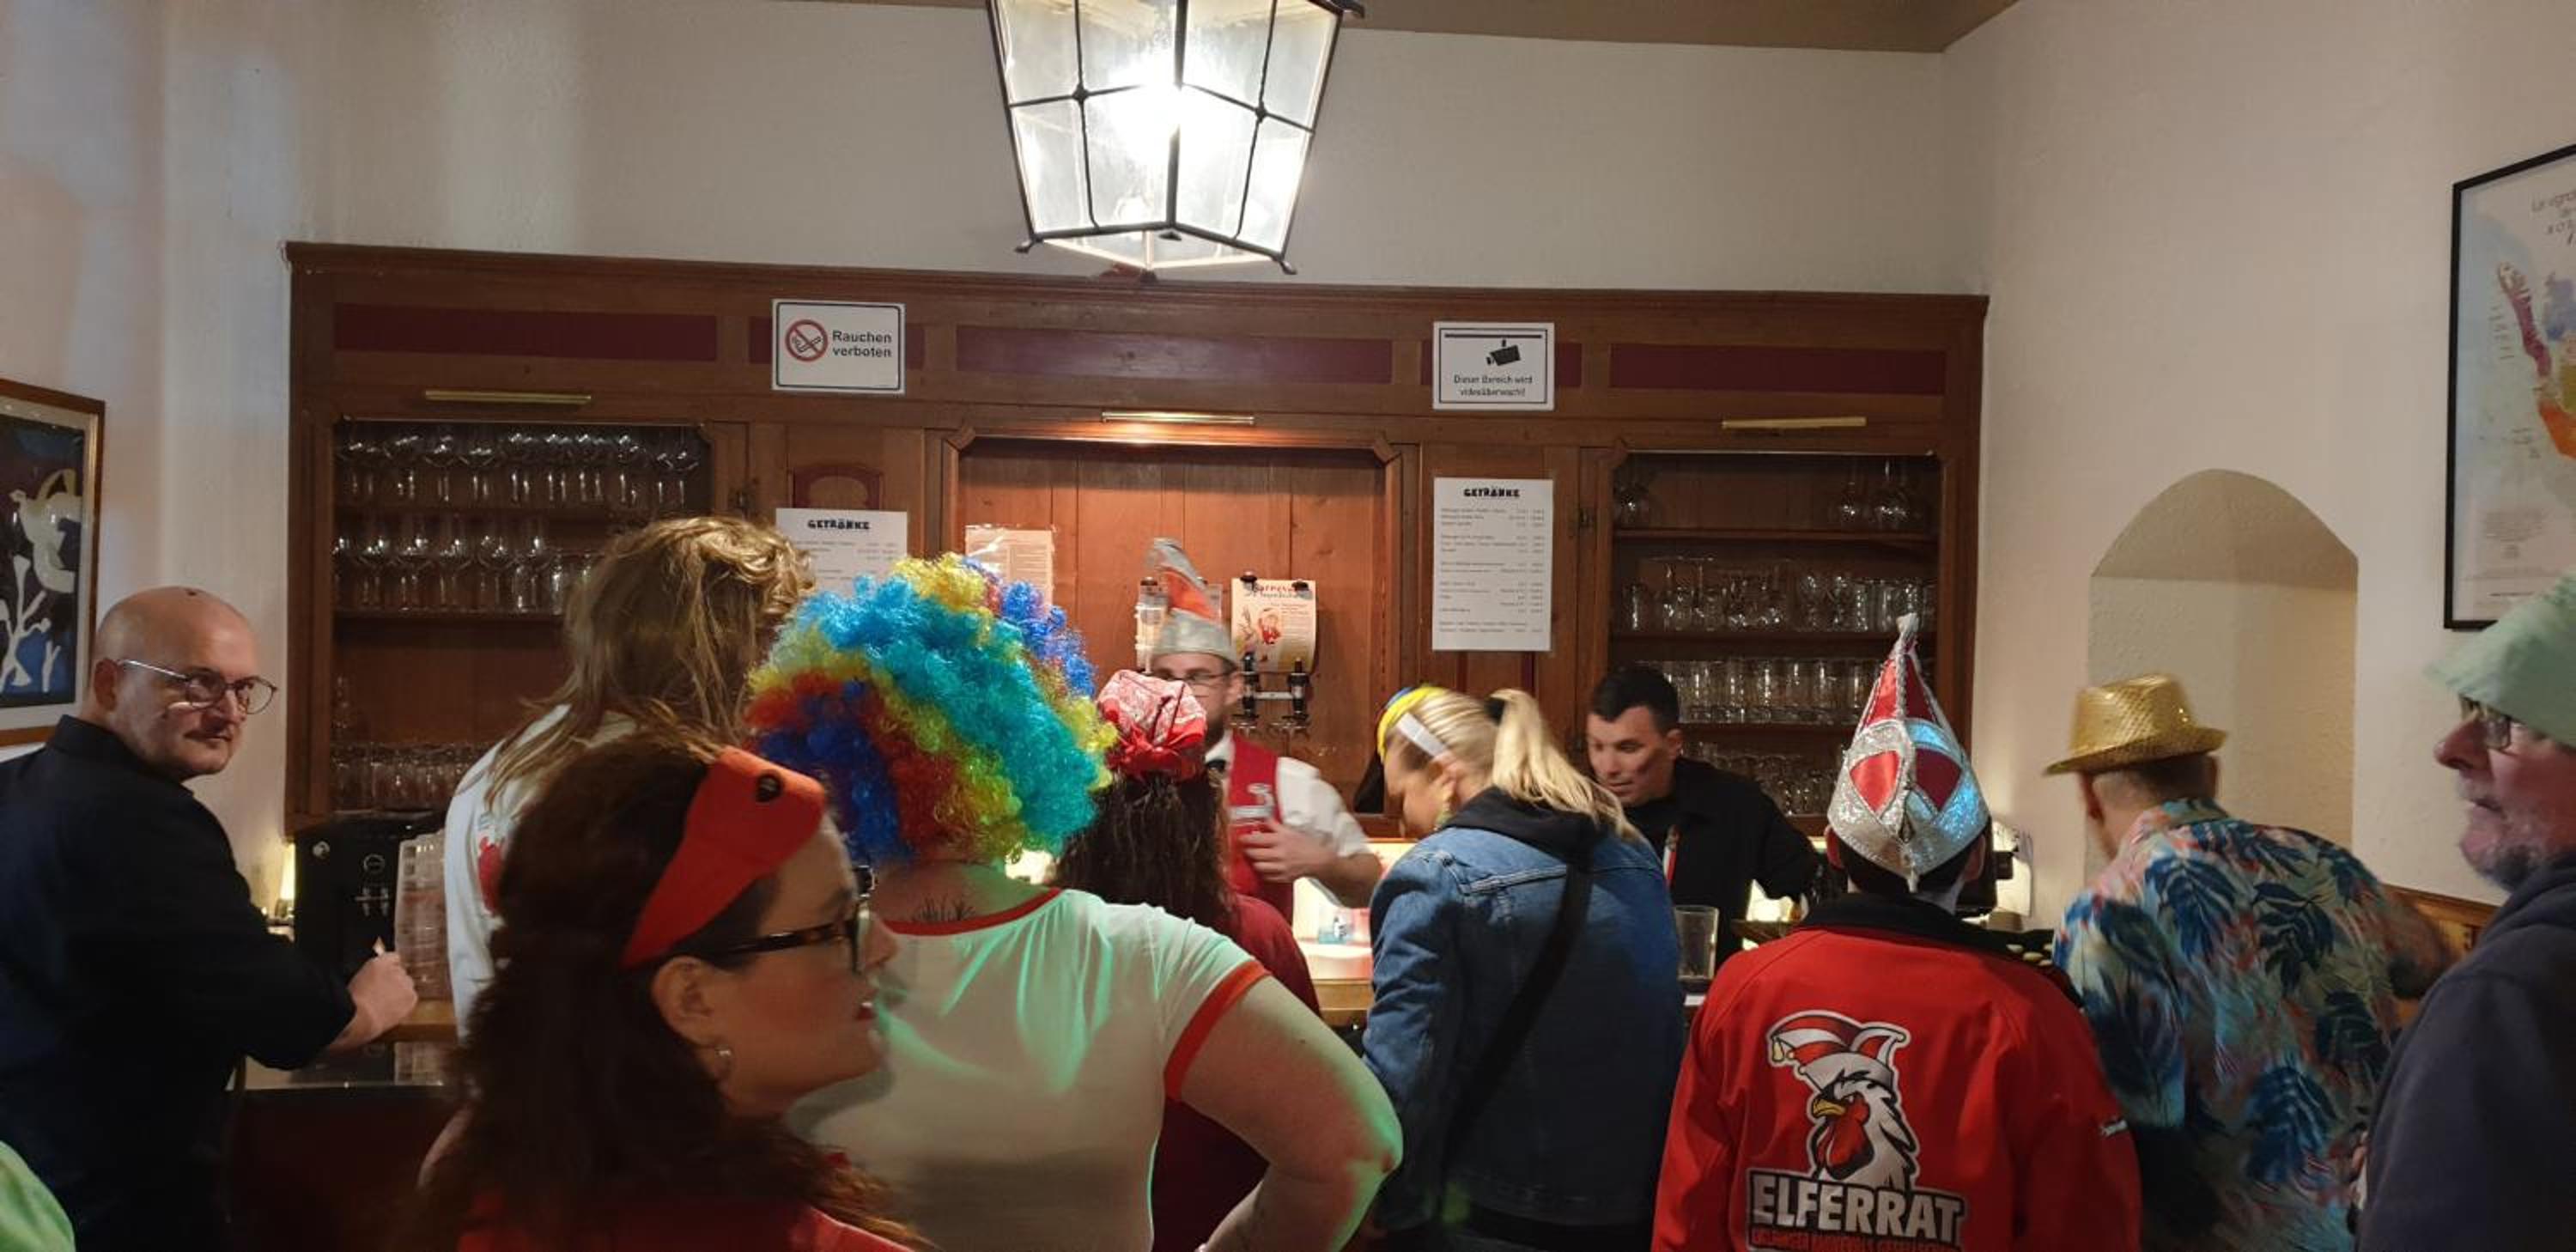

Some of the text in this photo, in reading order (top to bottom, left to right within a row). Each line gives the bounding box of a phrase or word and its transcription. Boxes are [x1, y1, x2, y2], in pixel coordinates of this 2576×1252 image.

[832, 331, 892, 343] Rauchen
[832, 346, 892, 357] verboten
[1454, 375, 1479, 384] Dieser
[1481, 375, 1511, 384] Bereich
[1463, 485, 1521, 497] GETRÄNKE
[807, 519, 870, 530] GETRÄNKE
[1752, 1174, 1962, 1243] ELFERRAT
